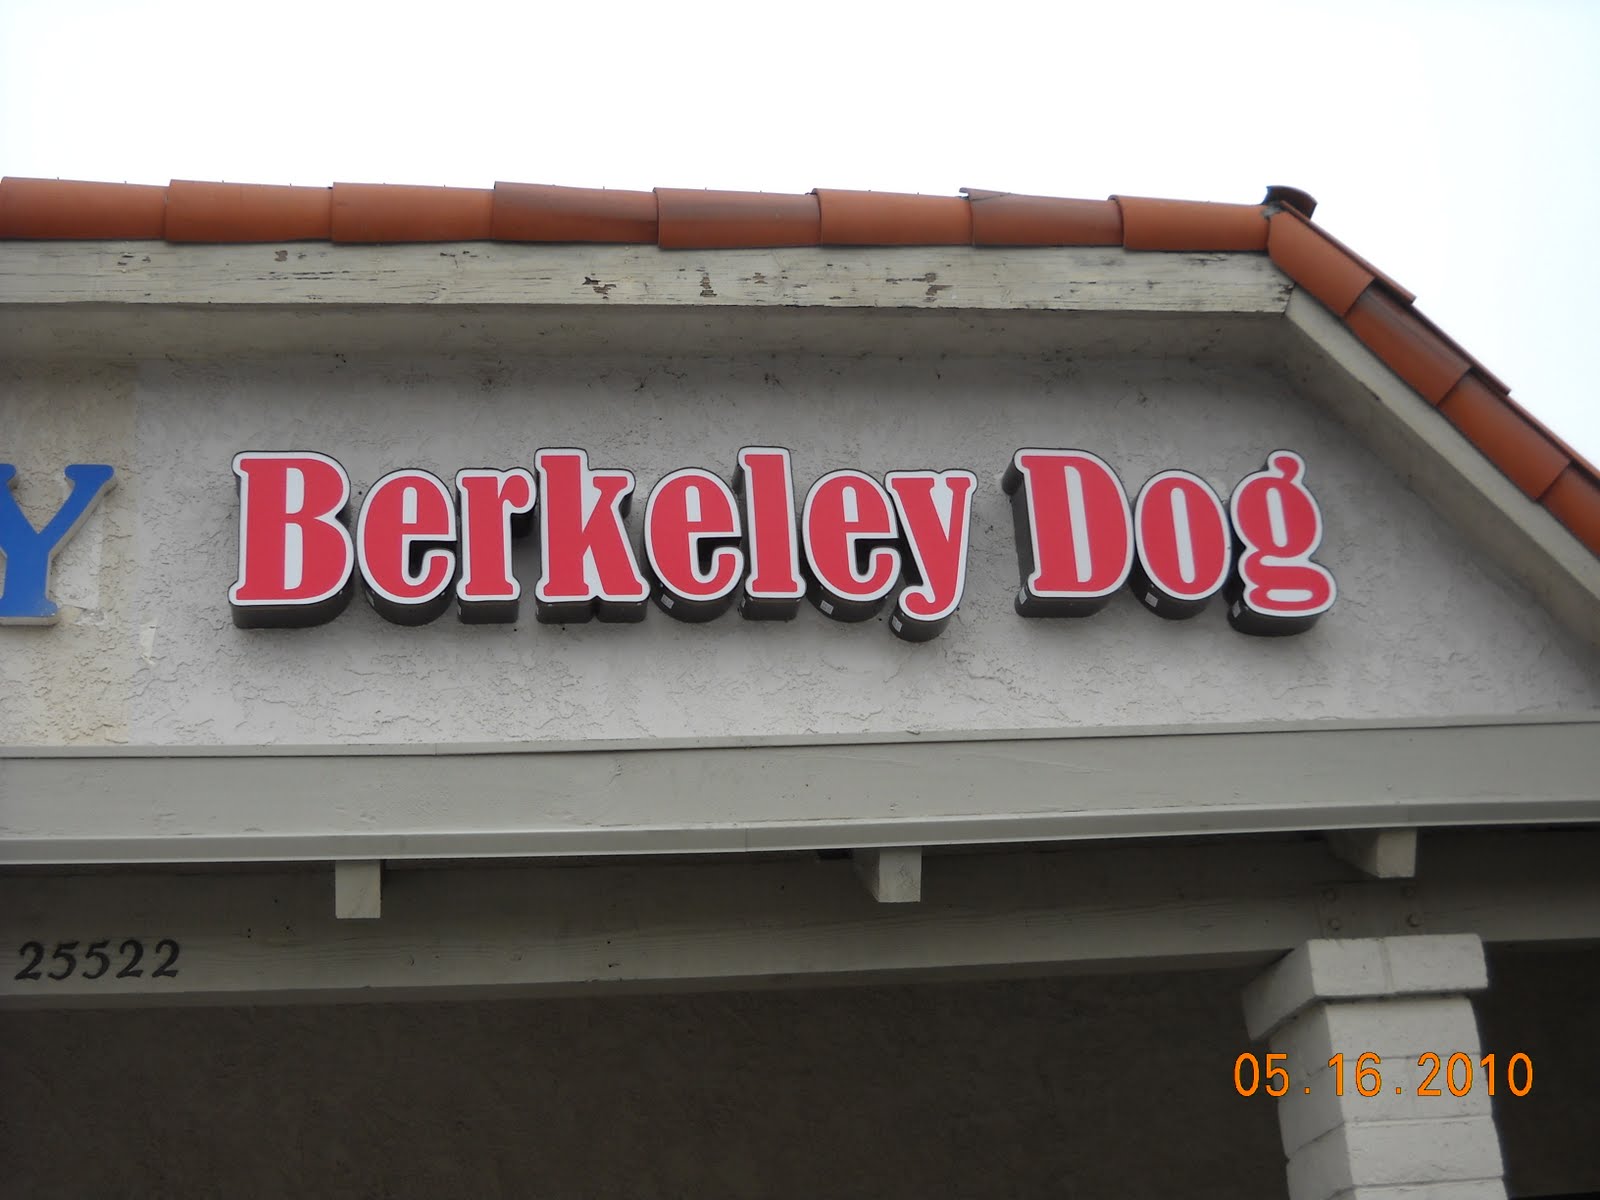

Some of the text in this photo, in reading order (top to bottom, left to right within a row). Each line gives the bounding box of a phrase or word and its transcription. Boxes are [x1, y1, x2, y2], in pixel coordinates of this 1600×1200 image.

[228, 447, 1337, 621] Berkeley Dog
[14, 939, 181, 981] 25522
